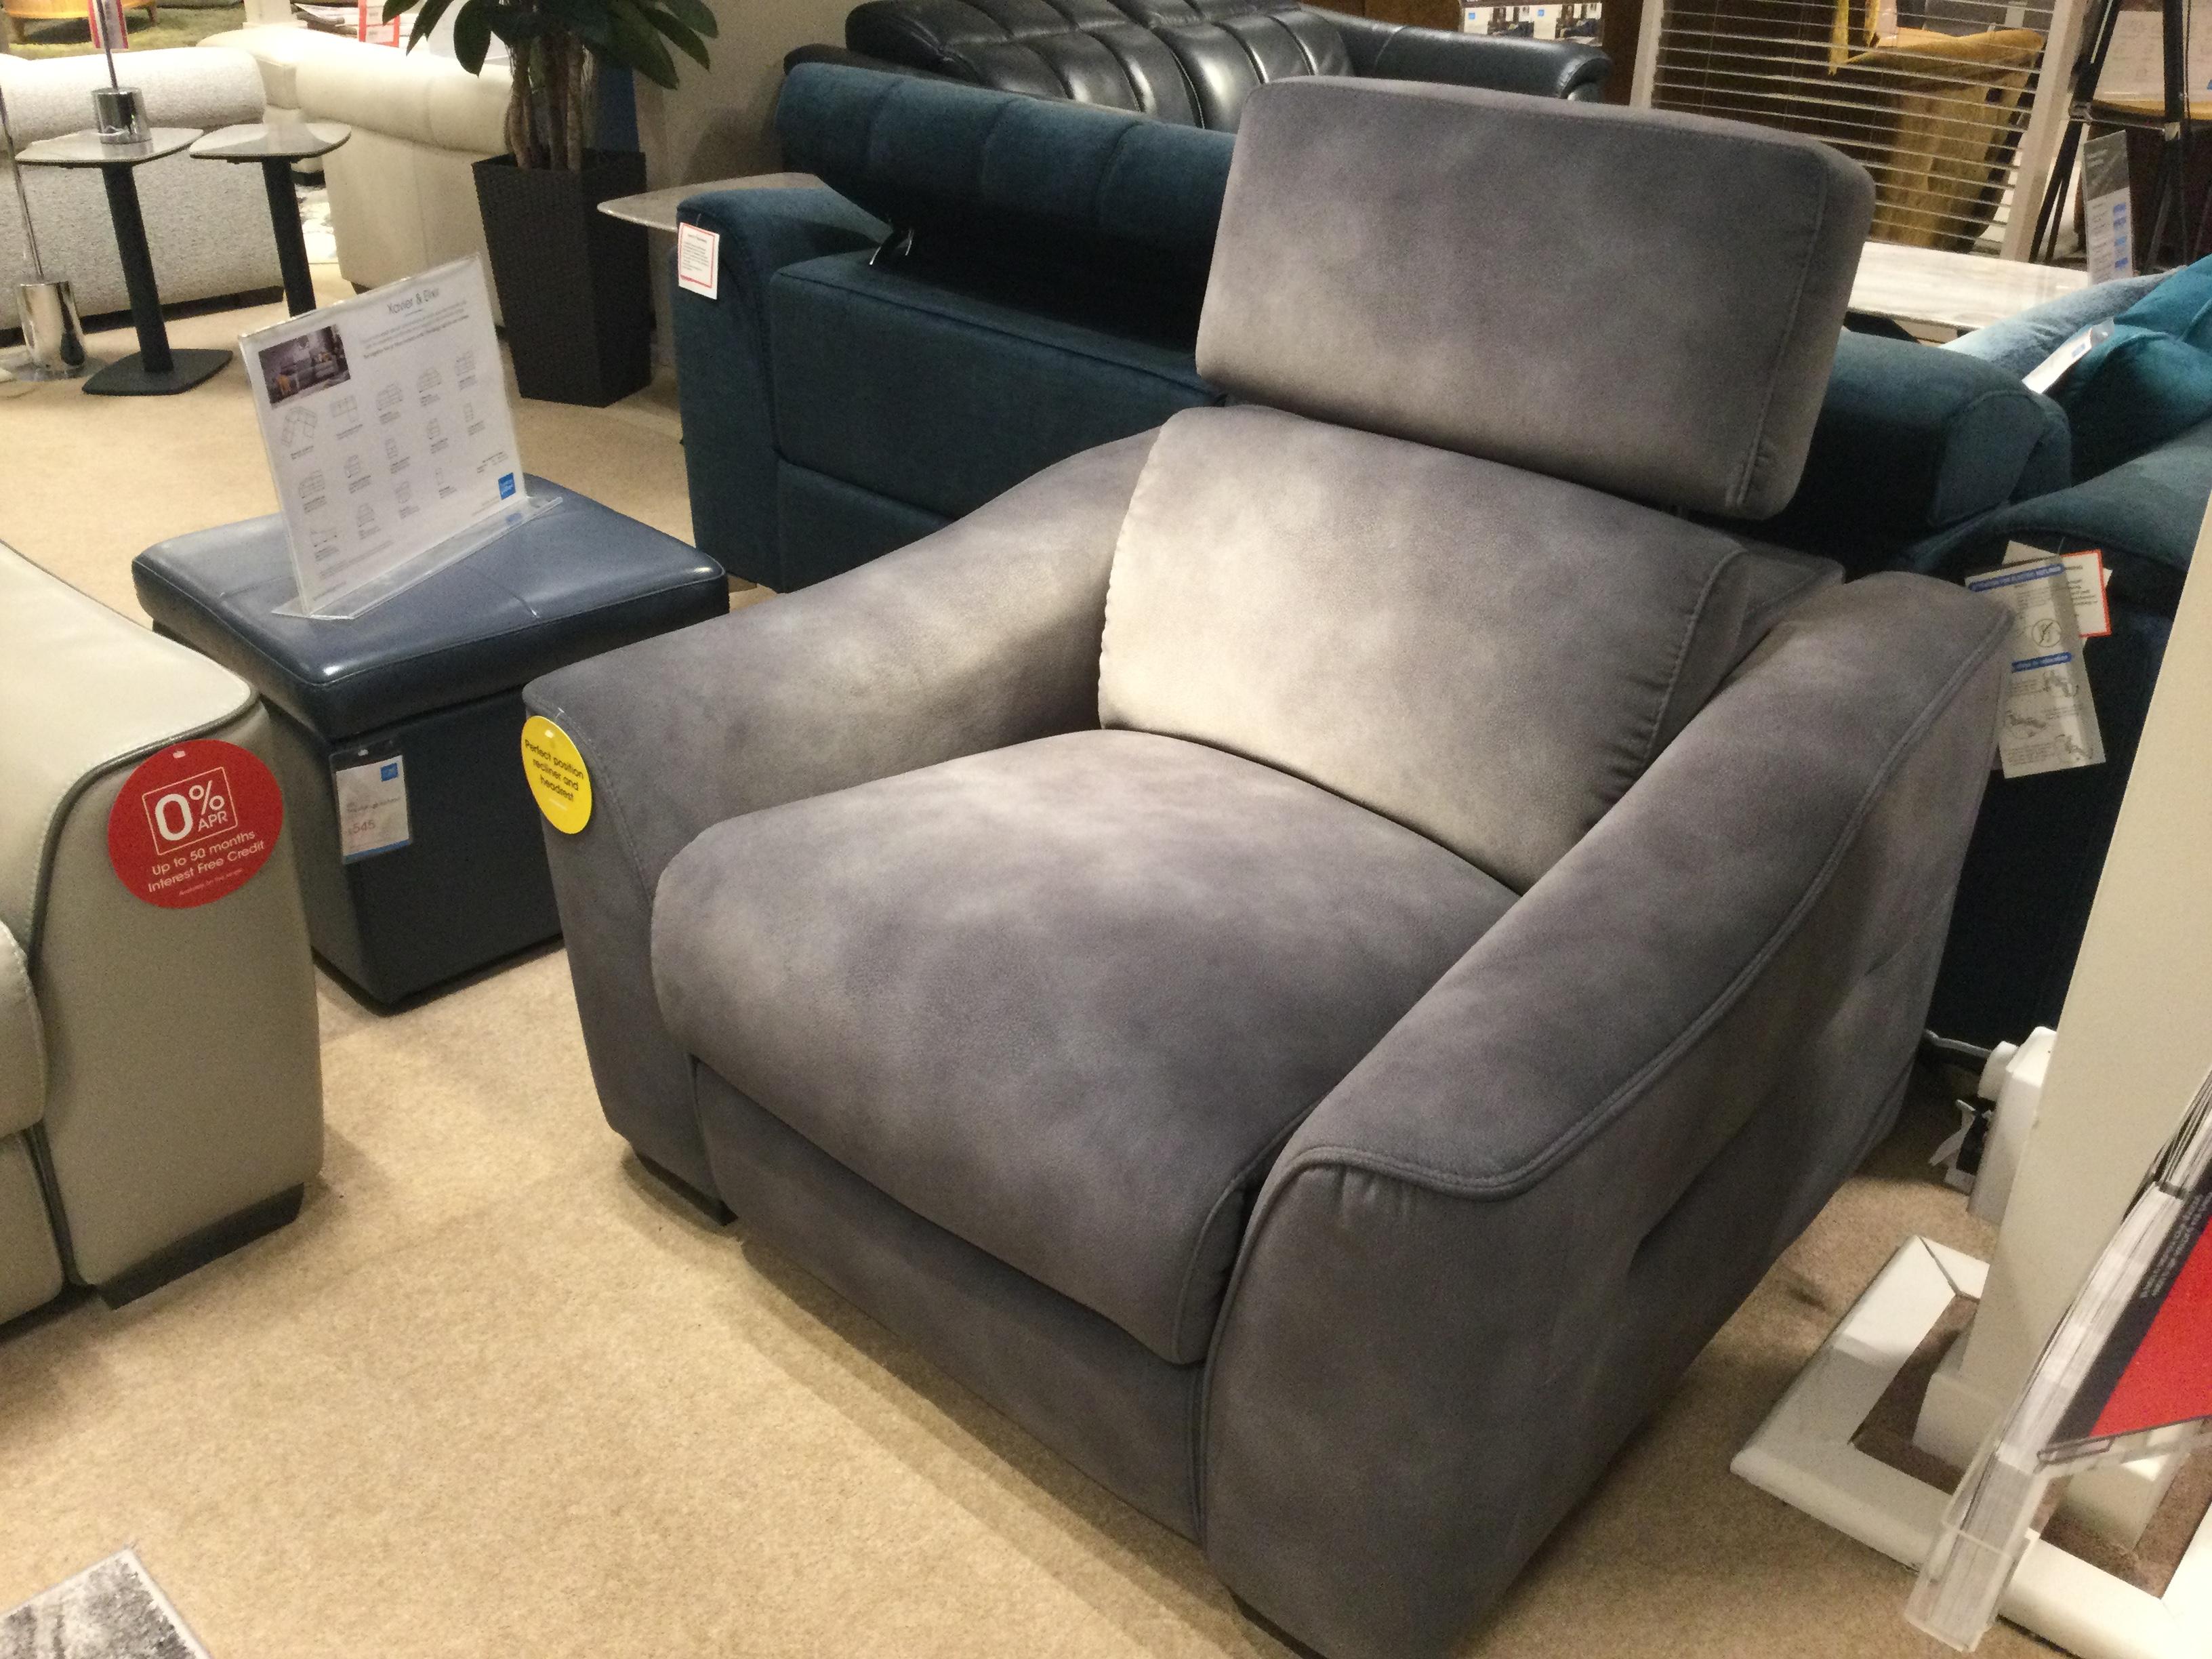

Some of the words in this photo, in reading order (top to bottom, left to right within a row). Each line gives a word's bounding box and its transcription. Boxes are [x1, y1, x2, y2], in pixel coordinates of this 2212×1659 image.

[525, 739, 551, 760] Perfect
[553, 757, 583, 779] position
[533, 759, 561, 781] recliner
[563, 777, 579, 792] and
[540, 774, 574, 802] headrest
[155, 780, 225, 840] 0%
[198, 811, 228, 832] APR
[148, 867, 194, 893] Interest
[197, 858, 224, 874] Free
[227, 840, 265, 862] Credit
[152, 863, 170, 876] Up
[173, 857, 187, 867] to
[190, 848, 207, 861] 50
[209, 831, 256, 855] months
